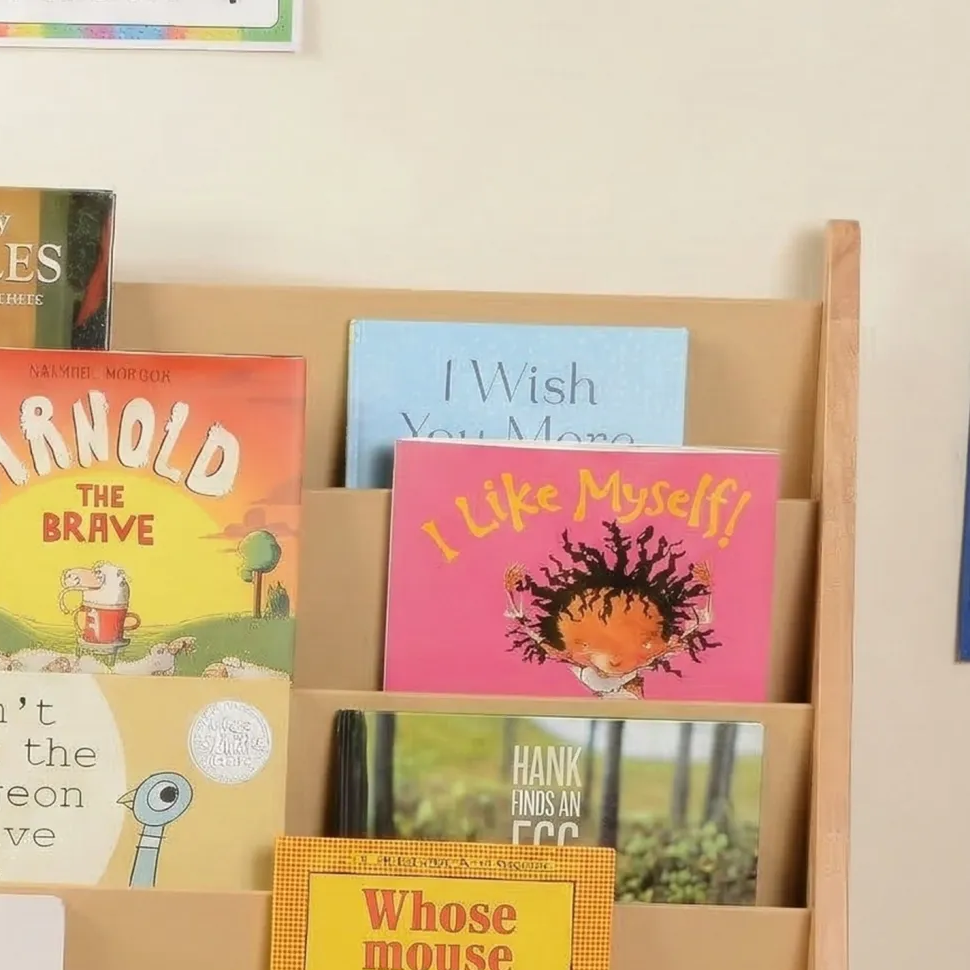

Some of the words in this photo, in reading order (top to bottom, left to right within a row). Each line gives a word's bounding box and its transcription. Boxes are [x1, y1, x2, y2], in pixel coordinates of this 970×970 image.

[444, 359, 453, 402] I
[470, 360, 598, 406] Wish
[76, 483, 125, 509] THE
[42, 511, 155, 546] BRAVE
[421, 520, 460, 563] I
[455, 472, 562, 538] Like
[573, 468, 752, 549] Myself!
[24, 737, 97, 768] the
[513, 745, 582, 787] HANK
[511, 789, 555, 817] FINDS
[558, 790, 581, 818] AN
[362, 888, 518, 936] Whose
